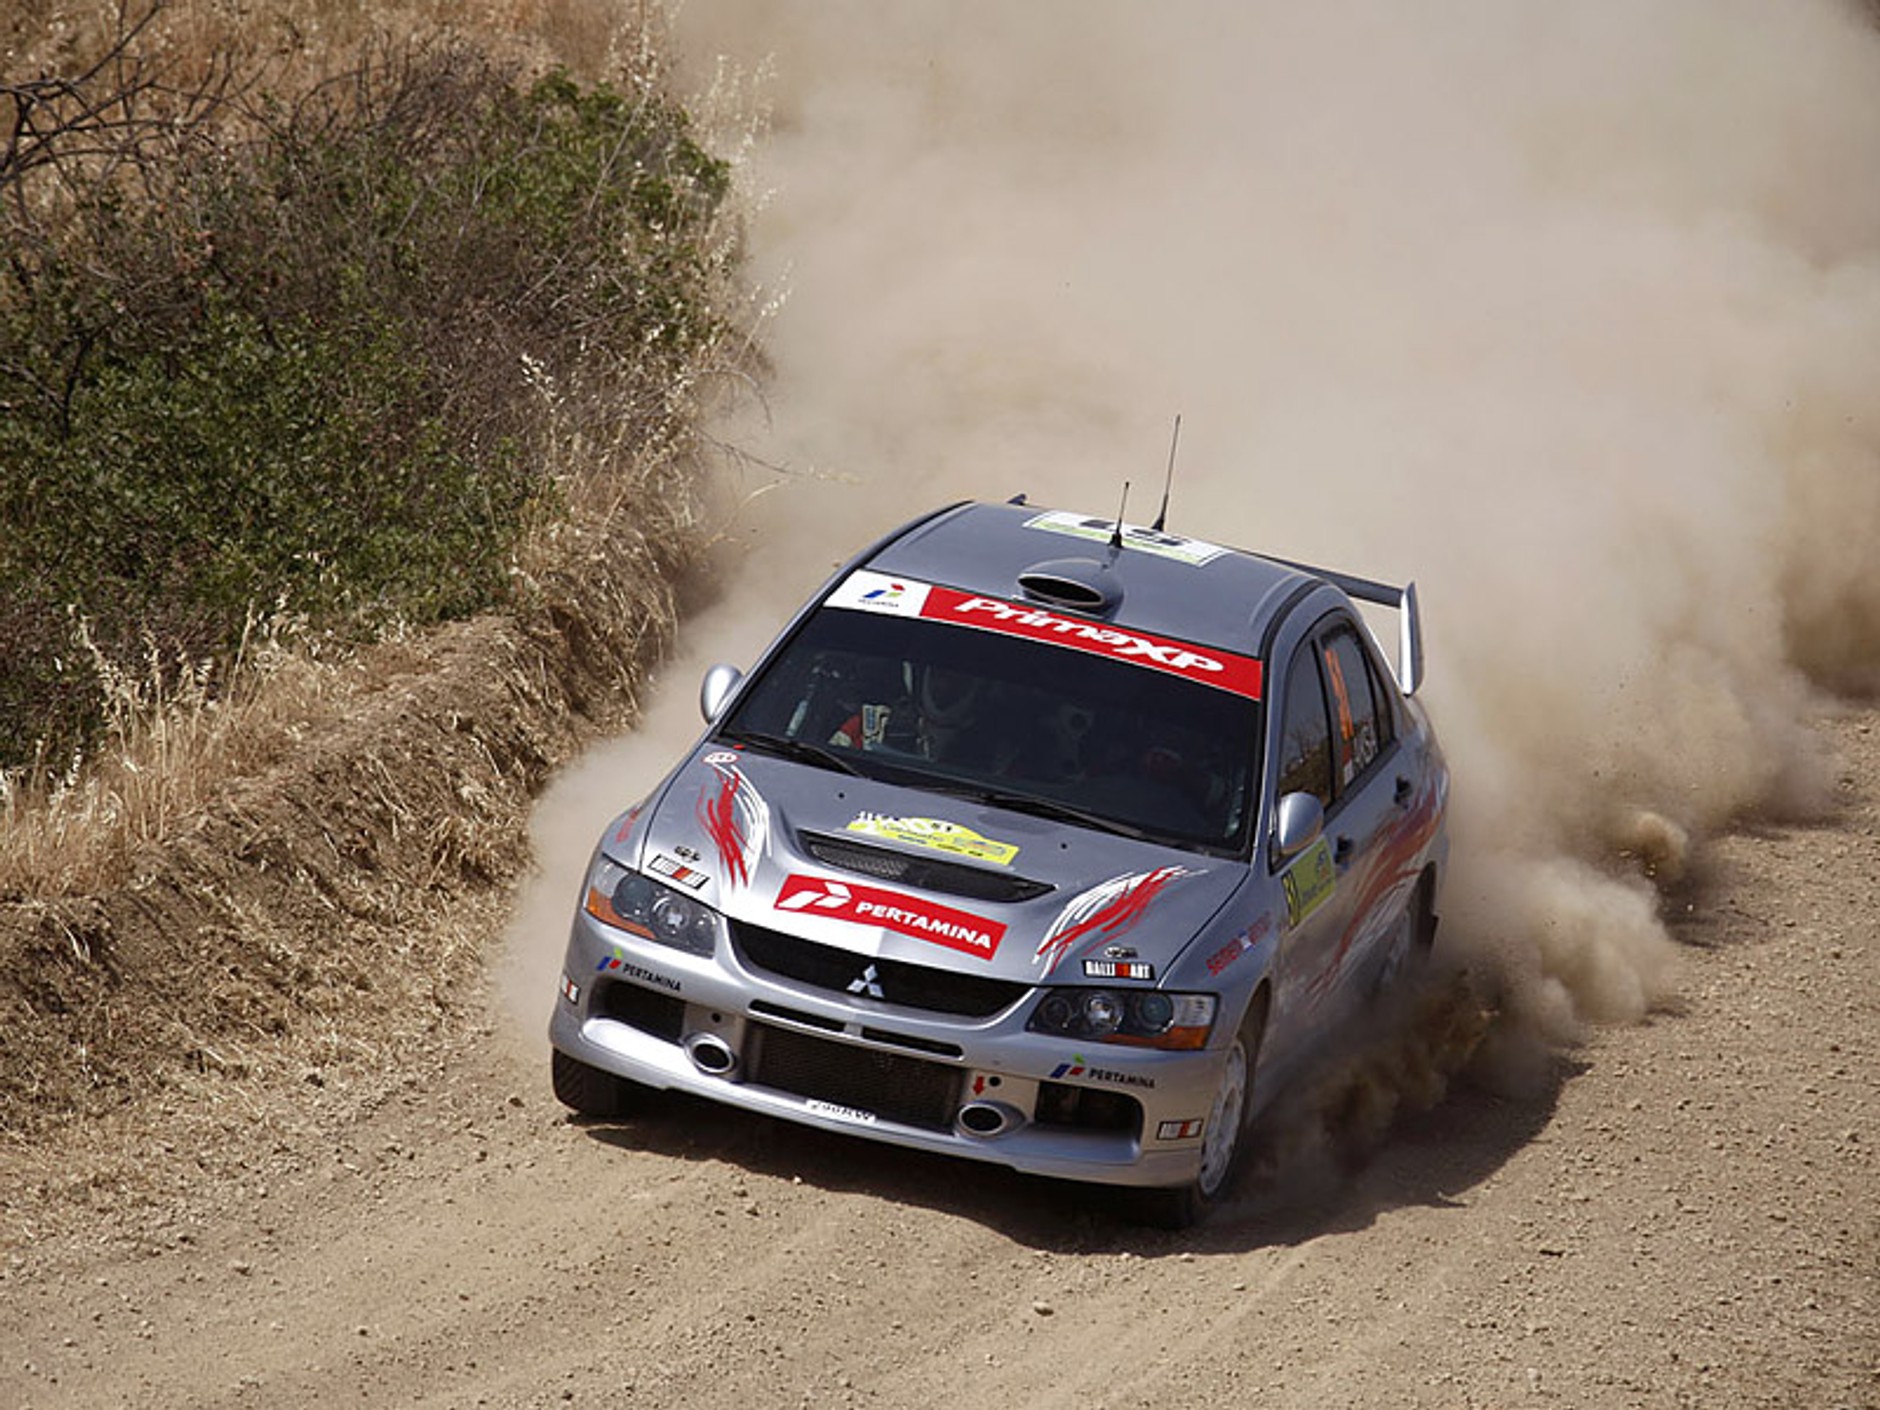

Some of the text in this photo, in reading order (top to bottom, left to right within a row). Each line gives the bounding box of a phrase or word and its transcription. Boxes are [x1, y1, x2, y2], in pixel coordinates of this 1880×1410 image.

[954, 597, 1224, 673] PrimaXP
[855, 901, 992, 949] PERTAMINA
[623, 963, 682, 992] PERTAMINA
[1089, 1068, 1156, 1089] PERTAMINA
